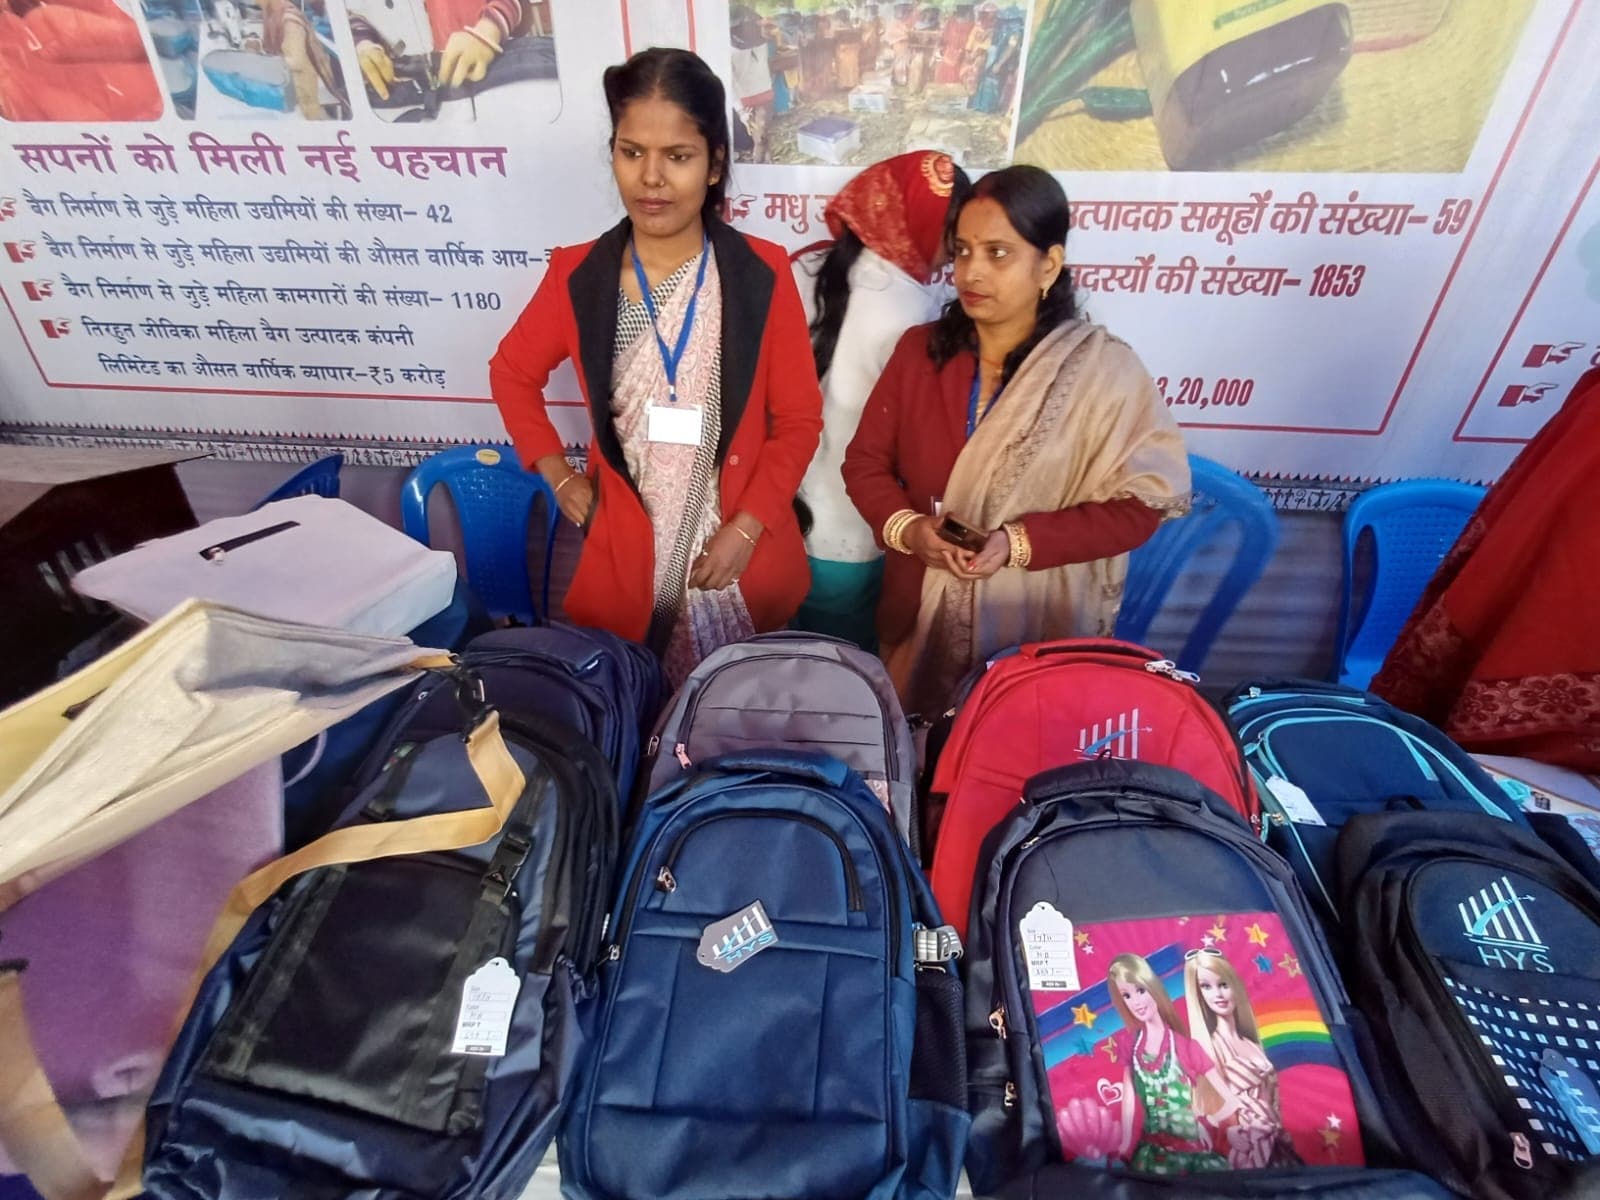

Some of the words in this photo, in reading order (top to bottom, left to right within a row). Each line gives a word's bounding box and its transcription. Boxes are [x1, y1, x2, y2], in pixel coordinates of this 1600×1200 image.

[12, 132, 118, 175] सपनों
[125, 132, 179, 175] को
[188, 131, 287, 175] मिली
[298, 130, 360, 182] नई
[370, 145, 508, 180] पहचान
[22, 188, 58, 217] बैग
[59, 191, 121, 218] निर्माण
[123, 193, 142, 218] से
[146, 194, 180, 227] जुड़े
[183, 193, 240, 222] महिला
[323, 196, 349, 221] की
[426, 204, 453, 223] 42
[764, 193, 810, 234] मधु
[1181, 189, 1273, 246] समूहों
[1269, 191, 1319, 234] की
[1318, 190, 1429, 235] संख्या-
[1432, 198, 1473, 235] 59
[41, 230, 75, 259] बैग
[77, 235, 138, 260] निर्माण
[140, 237, 160, 261] से
[163, 237, 195, 268] जुड़े
[198, 237, 255, 265] महिला
[335, 240, 361, 264] की
[368, 237, 421, 266] औसत
[424, 241, 484, 268] वार्षिक
[60, 273, 92, 299] बैग
[96, 276, 154, 300] निर्माण
[157, 278, 176, 301] से
[179, 279, 209, 309] जुड़े
[214, 280, 269, 305] महिला
[272, 282, 348, 305] कामगारों
[353, 283, 378, 307] की
[450, 291, 502, 311] 1180
[1155, 255, 1199, 294] की
[1201, 255, 1301, 296] संख्या-
[1309, 264, 1366, 297] 1853
[81, 315, 136, 344] तिरहुत
[139, 317, 201, 340] जीविका
[205, 319, 258, 344] महिला
[262, 317, 291, 342] बैग
[295, 327, 361, 345] उत्पादक
[365, 324, 415, 347] कंपनी
[97, 352, 161, 376] लिमिटेड
[164, 360, 187, 376] का
[192, 353, 240, 378] औसत
[242, 357, 296, 380] वार्षिक
[399, 363, 446, 389] करोड़
[1478, 946, 1555, 973] HYS
